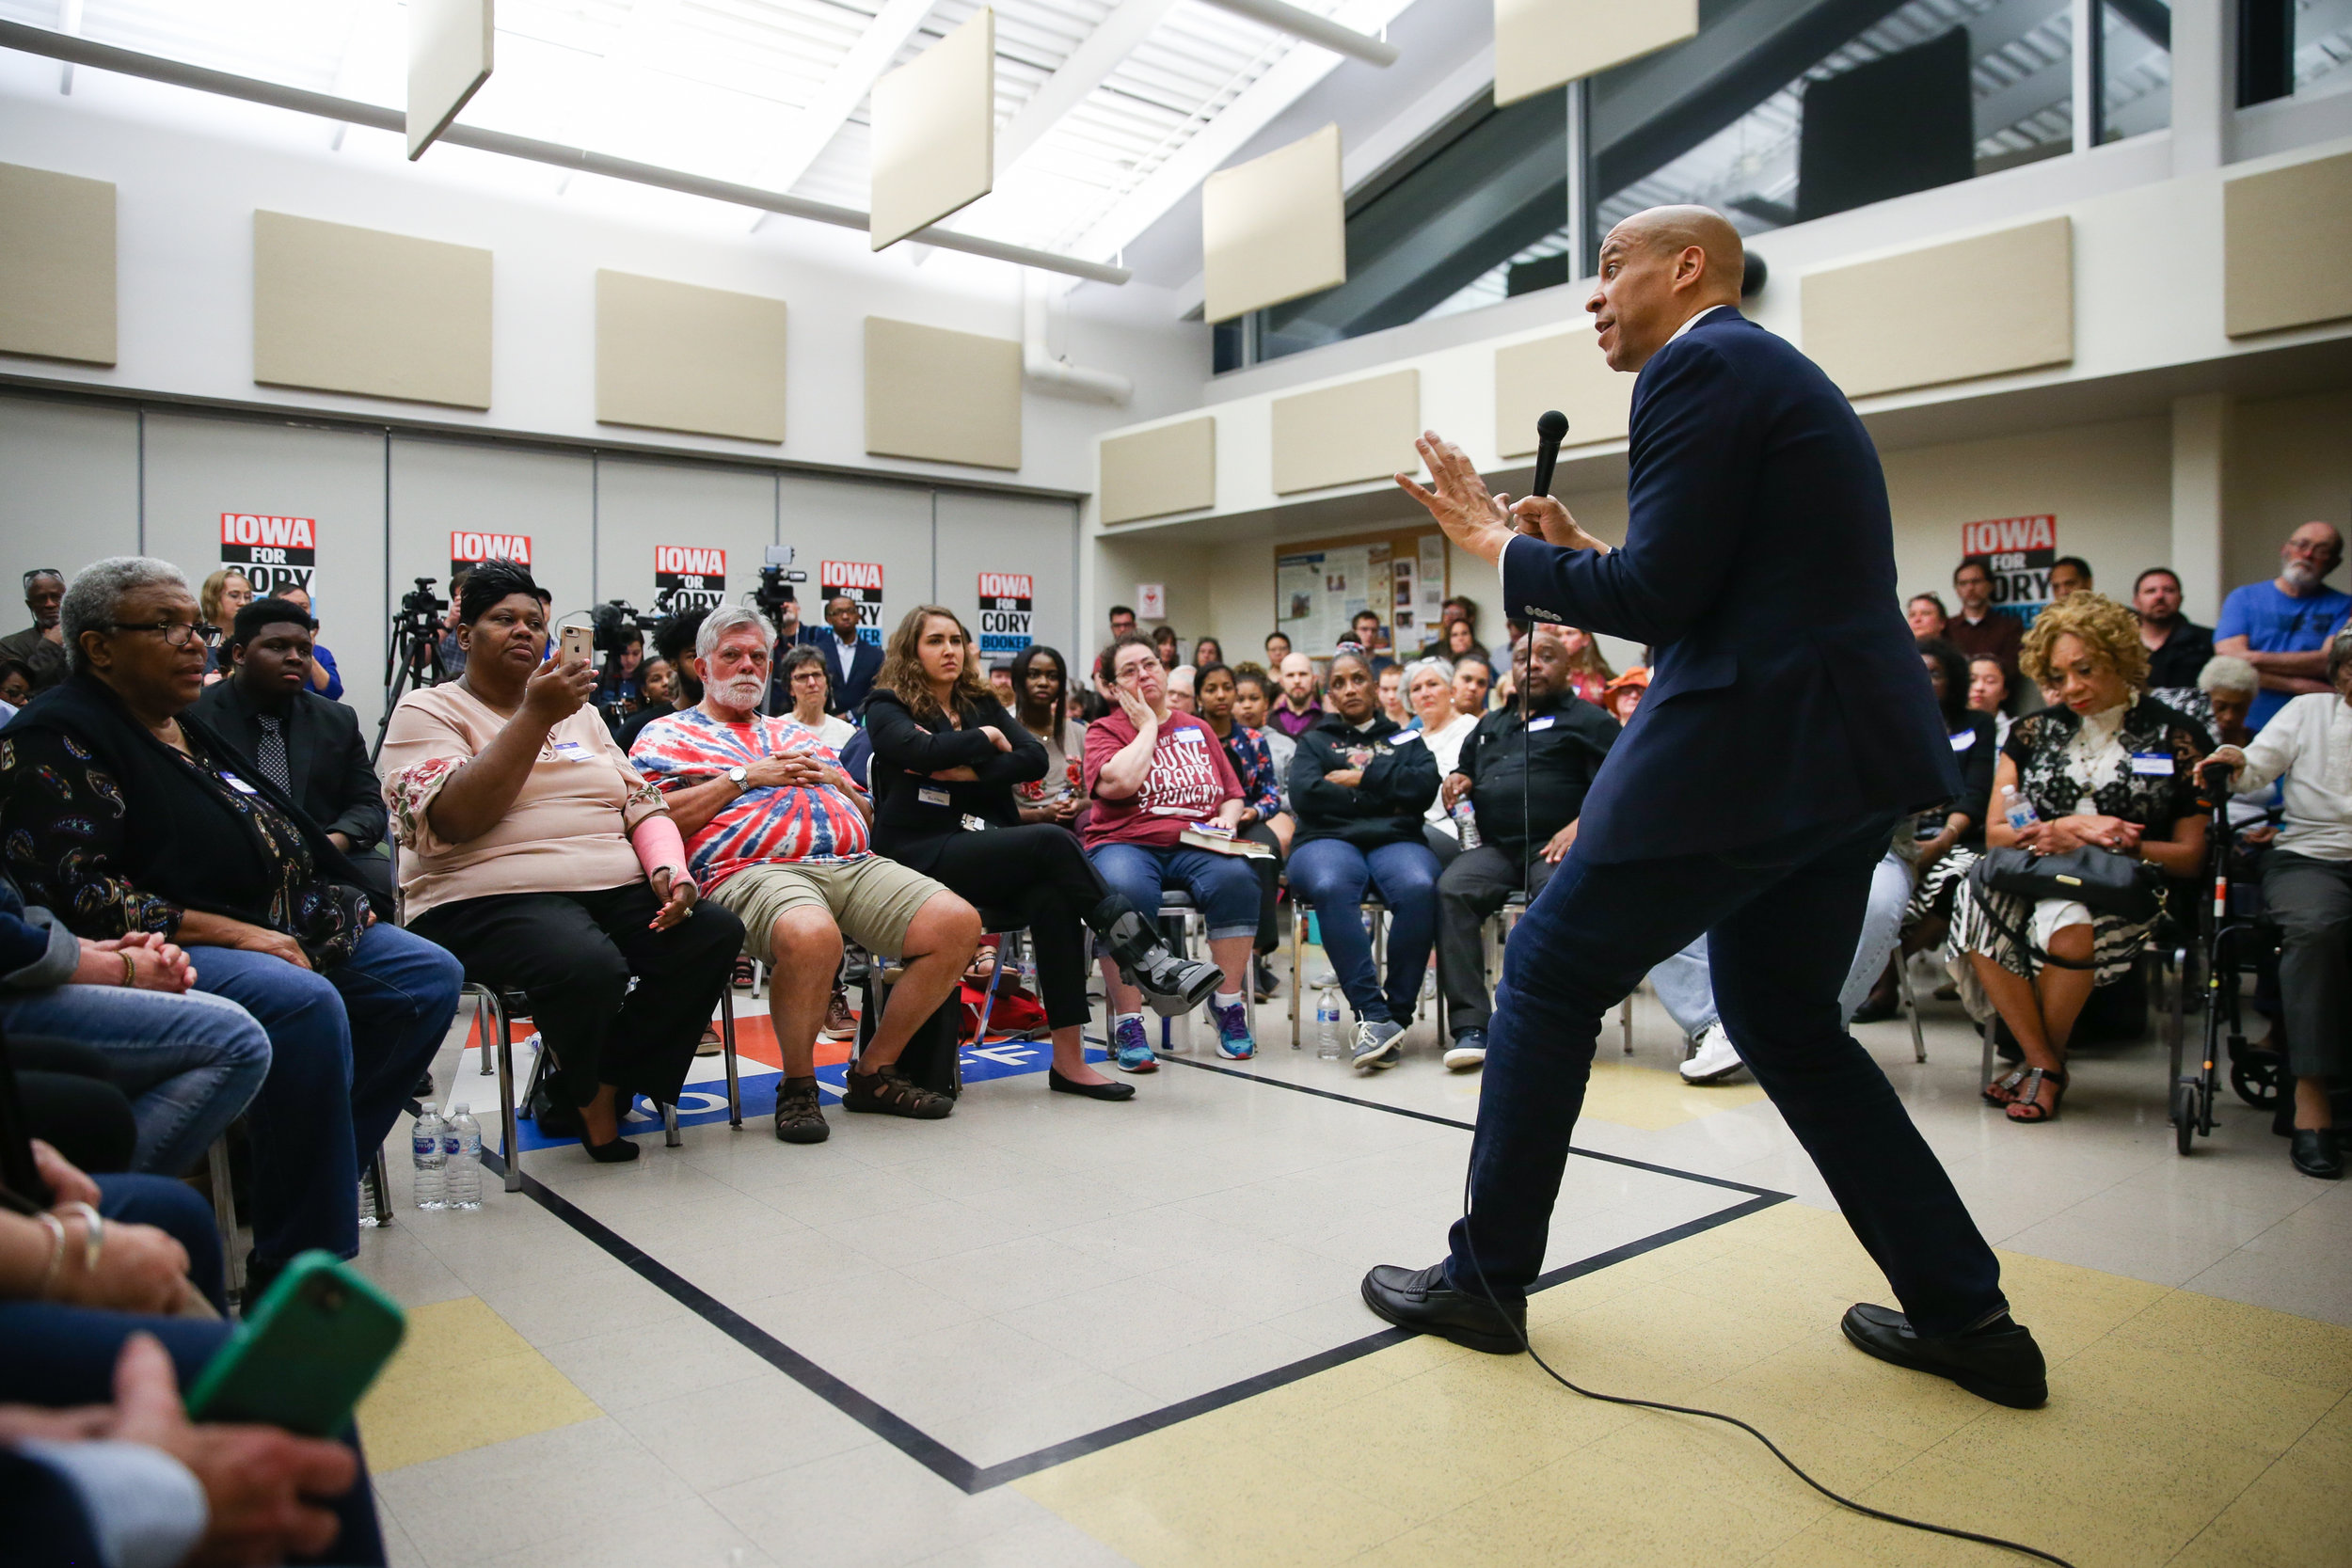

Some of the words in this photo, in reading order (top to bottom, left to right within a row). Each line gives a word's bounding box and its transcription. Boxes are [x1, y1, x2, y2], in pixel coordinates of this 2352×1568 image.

[225, 515, 313, 547] IOWA
[1967, 518, 2053, 553] IOWA
[250, 546, 287, 564] FOR
[453, 532, 529, 562] IOWA
[659, 546, 724, 575] IOWA
[1990, 552, 2026, 571] FOR
[823, 562, 882, 588] IOWA
[981, 574, 1031, 597] IOWA
[1990, 572, 2050, 603] ORY
[995, 597, 1017, 610] FOR
[982, 612, 1031, 633] CORY
[981, 635, 1032, 649] BOOKER
[1151, 740, 1211, 771] OUNG
